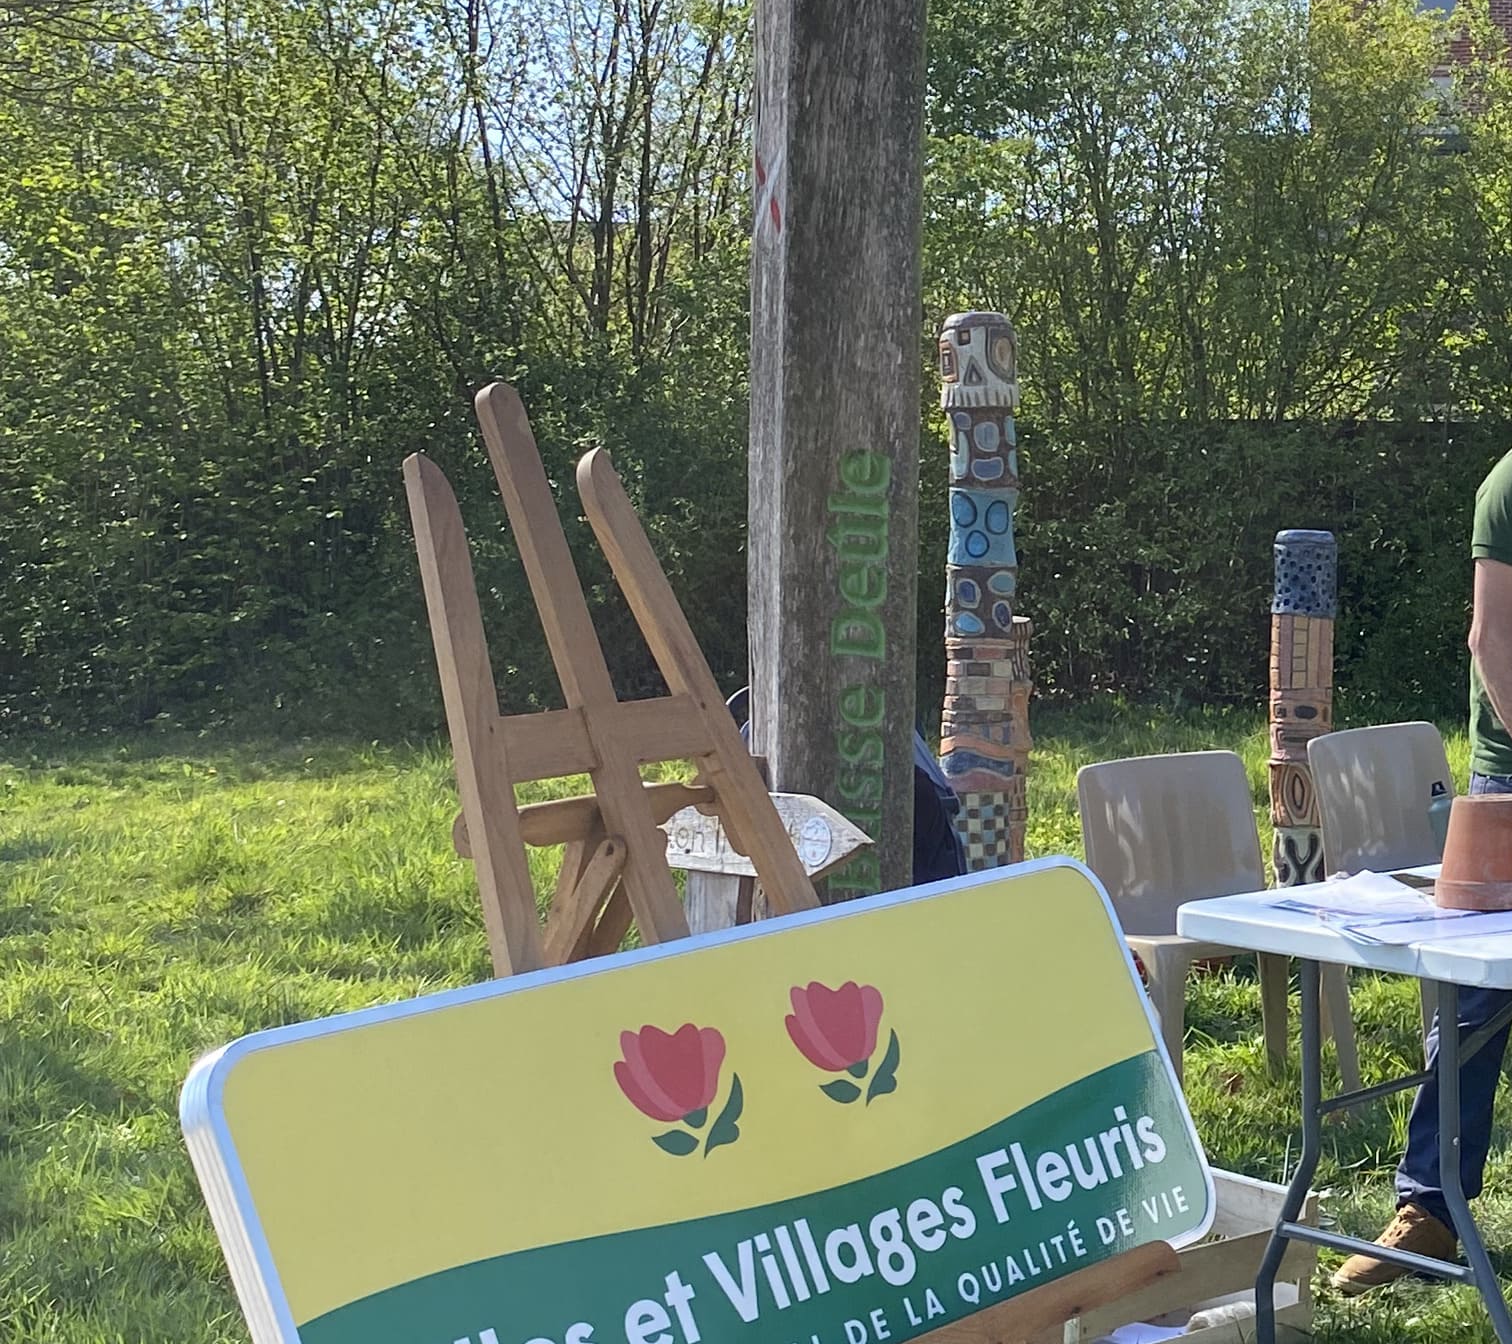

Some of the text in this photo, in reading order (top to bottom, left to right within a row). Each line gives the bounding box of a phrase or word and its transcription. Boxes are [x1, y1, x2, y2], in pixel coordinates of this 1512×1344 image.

[827, 447, 891, 658] Deûle
[702, 1185, 976, 1311] Villages
[976, 1106, 1168, 1225] Fleuris
[904, 1287, 946, 1328] LA
[956, 1219, 1087, 1307] QUALITÉ
[1096, 1208, 1135, 1245] DE
[1142, 1184, 1190, 1224] VIE
